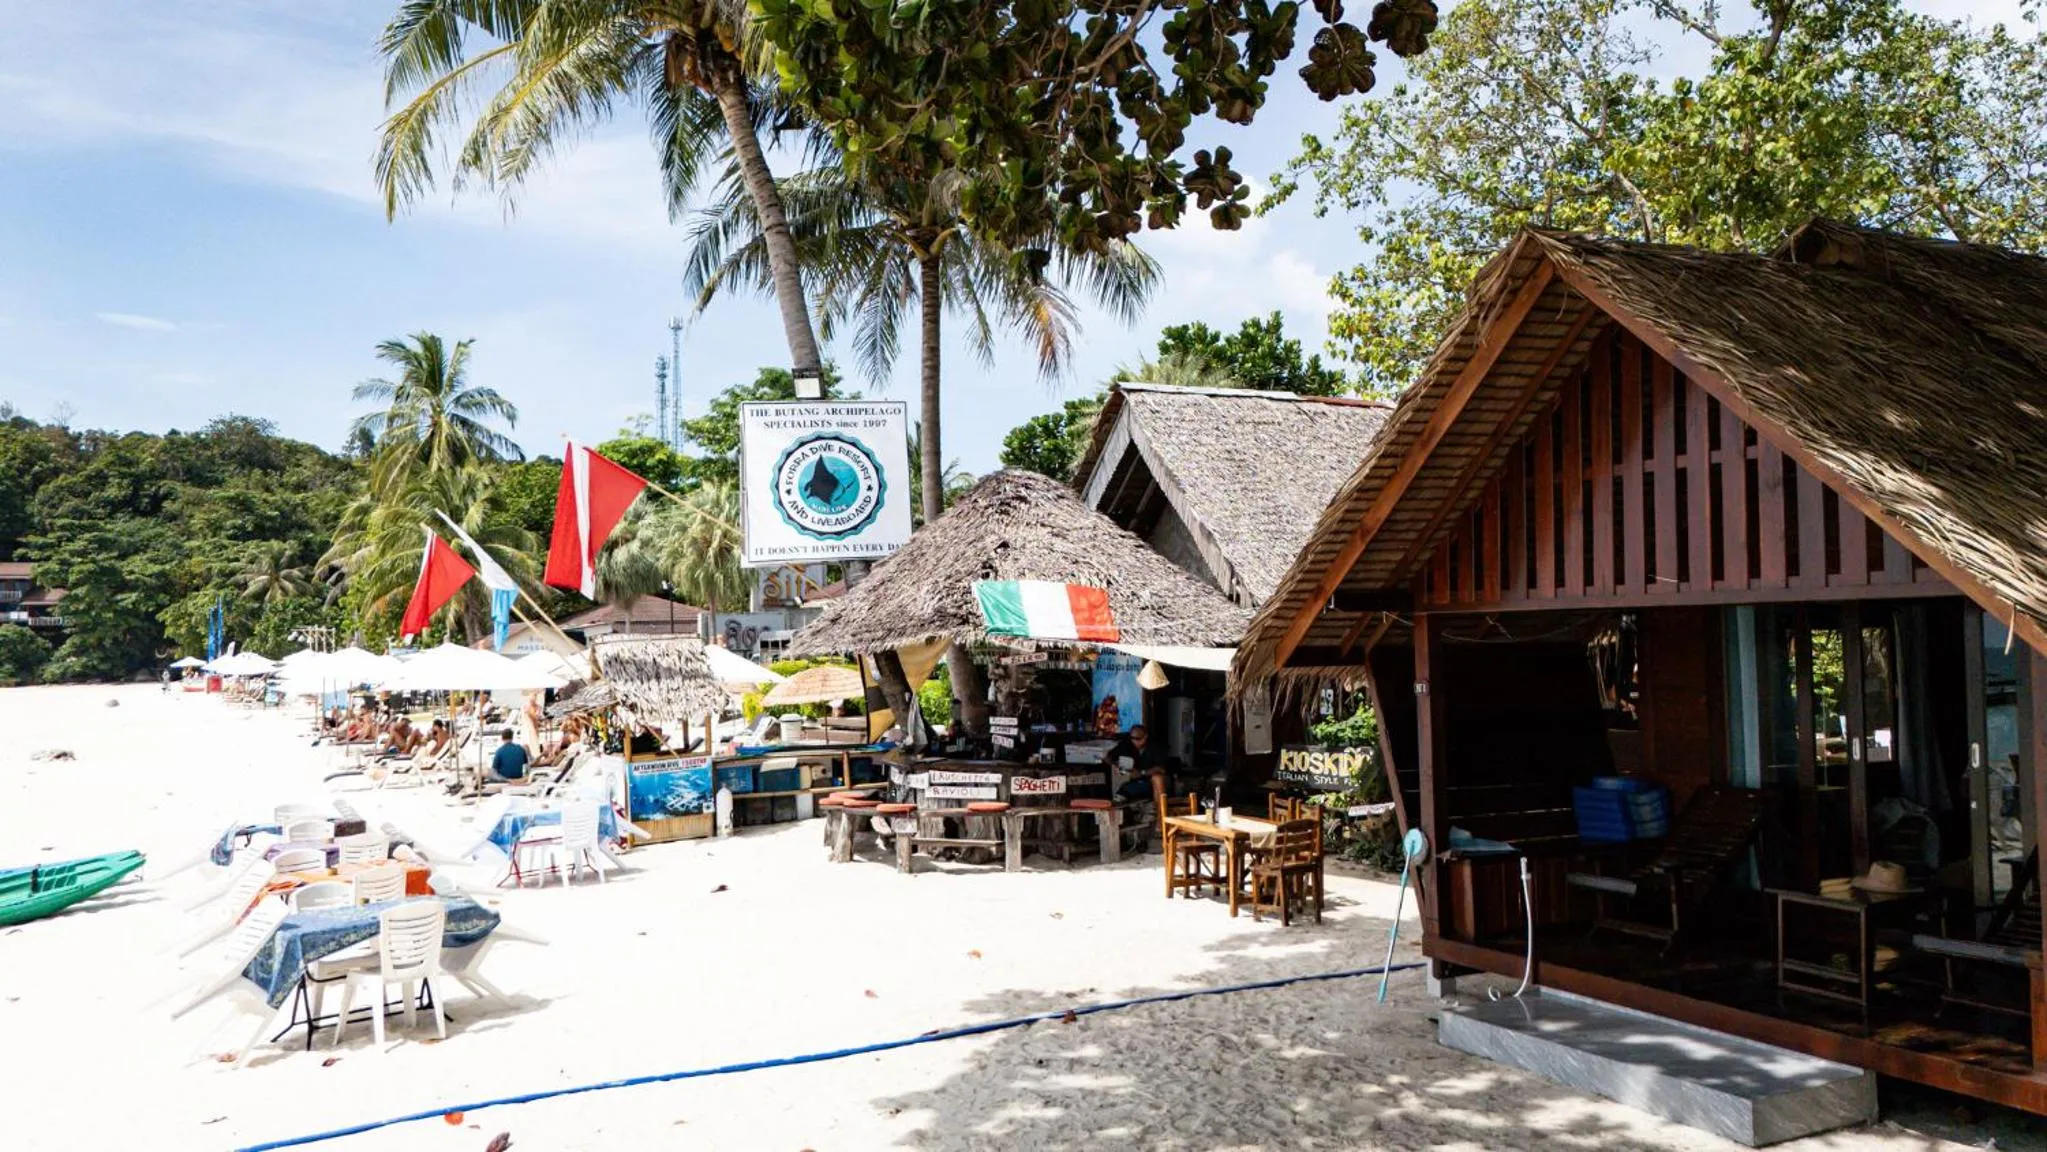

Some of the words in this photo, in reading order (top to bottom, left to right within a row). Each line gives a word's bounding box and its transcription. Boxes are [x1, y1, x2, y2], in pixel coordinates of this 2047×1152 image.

[750, 408, 771, 417] THE
[775, 407, 820, 417] BUTANG
[824, 406, 901, 416] ARCHIPELAGO
[763, 419, 832, 429] SPECIALISTS
[836, 420, 858, 429] since
[809, 442, 835, 455] DIVE
[838, 446, 872, 480] RESORT
[788, 500, 809, 520] AND
[811, 495, 872, 526] LIVEABOARD
[768, 545, 808, 555] DOESN'T
[812, 544, 850, 554] HAPPEN
[853, 543, 884, 553] EVERY
[888, 542, 903, 552] DA
[1014, 777, 1060, 791] SPAGHETTI
[1277, 771, 1308, 781] ITALIAN
[1313, 775, 1339, 785] STYLE
